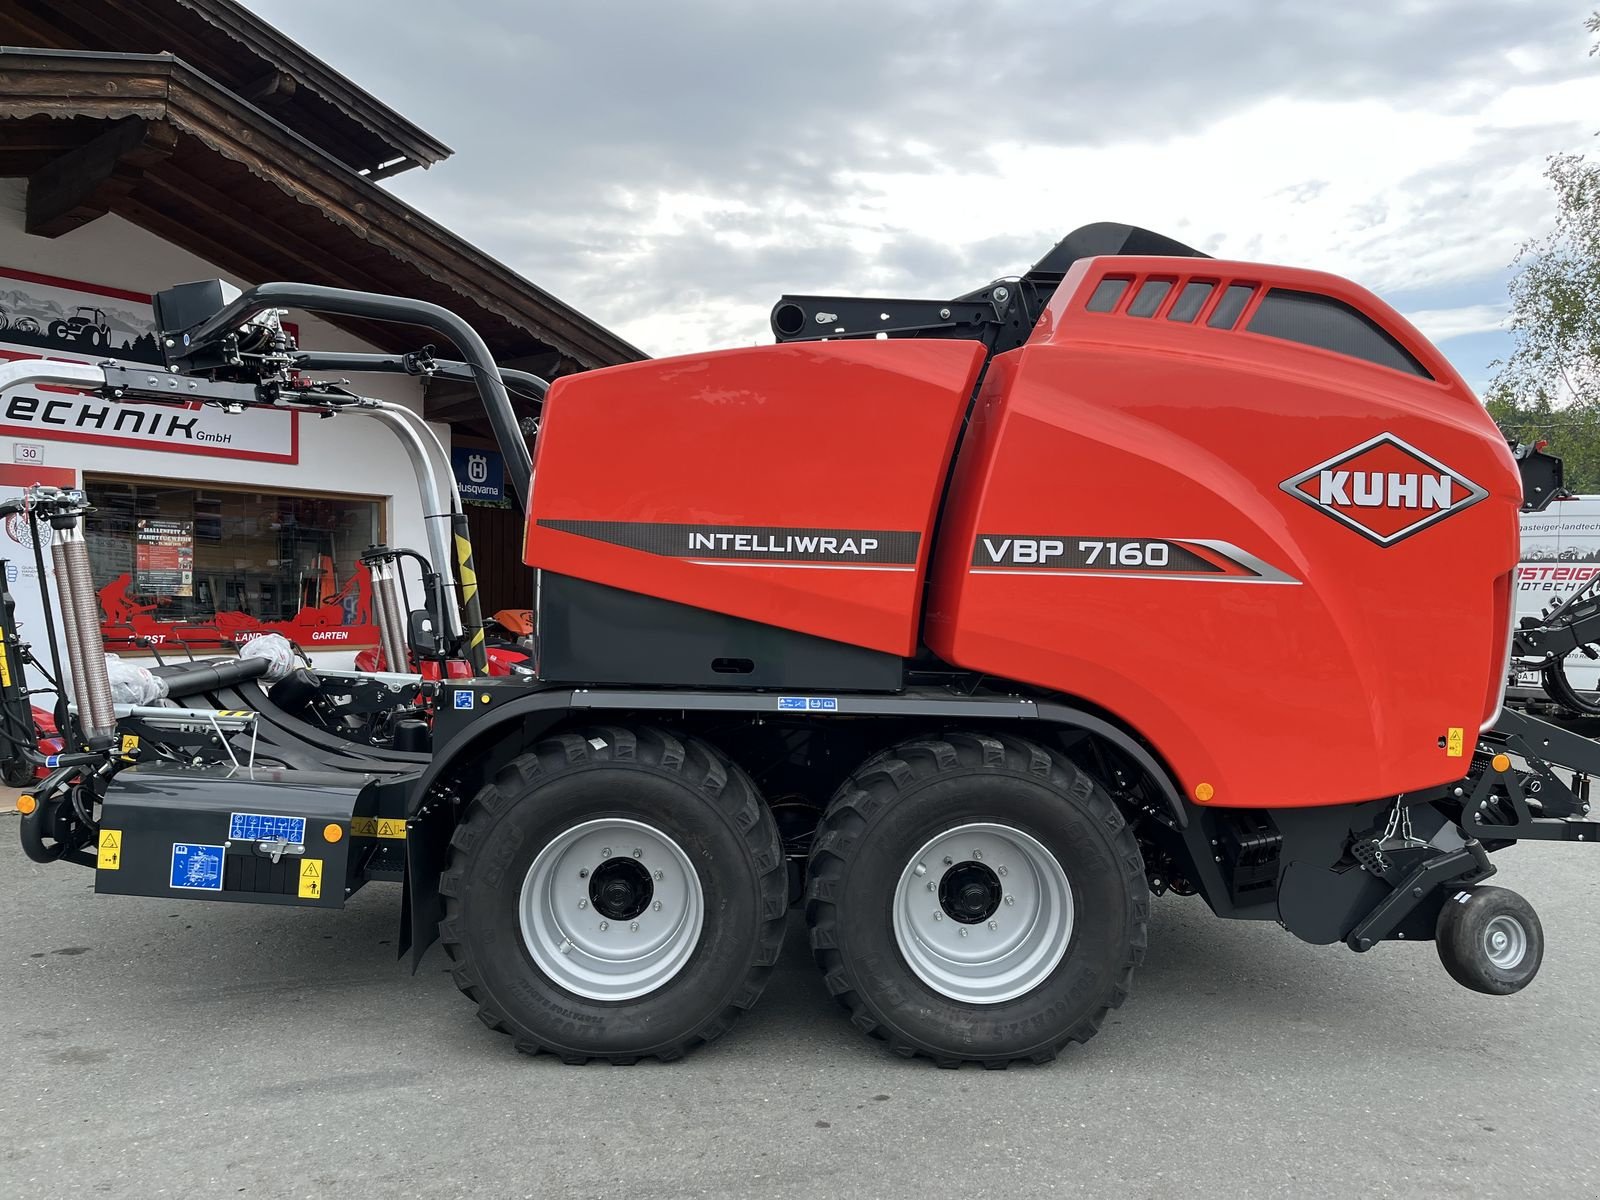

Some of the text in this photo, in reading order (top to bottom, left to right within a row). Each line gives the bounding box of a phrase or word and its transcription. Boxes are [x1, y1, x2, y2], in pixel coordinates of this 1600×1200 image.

[196, 431, 232, 443] GmbH
[22, 448, 37, 458] 30
[457, 482, 499, 495] Husqvarna
[1319, 470, 1452, 509] KUHN
[688, 532, 878, 555] INTELLIWRAP
[983, 538, 1170, 567] VBP 7160
[312, 631, 349, 640] GARTEN
